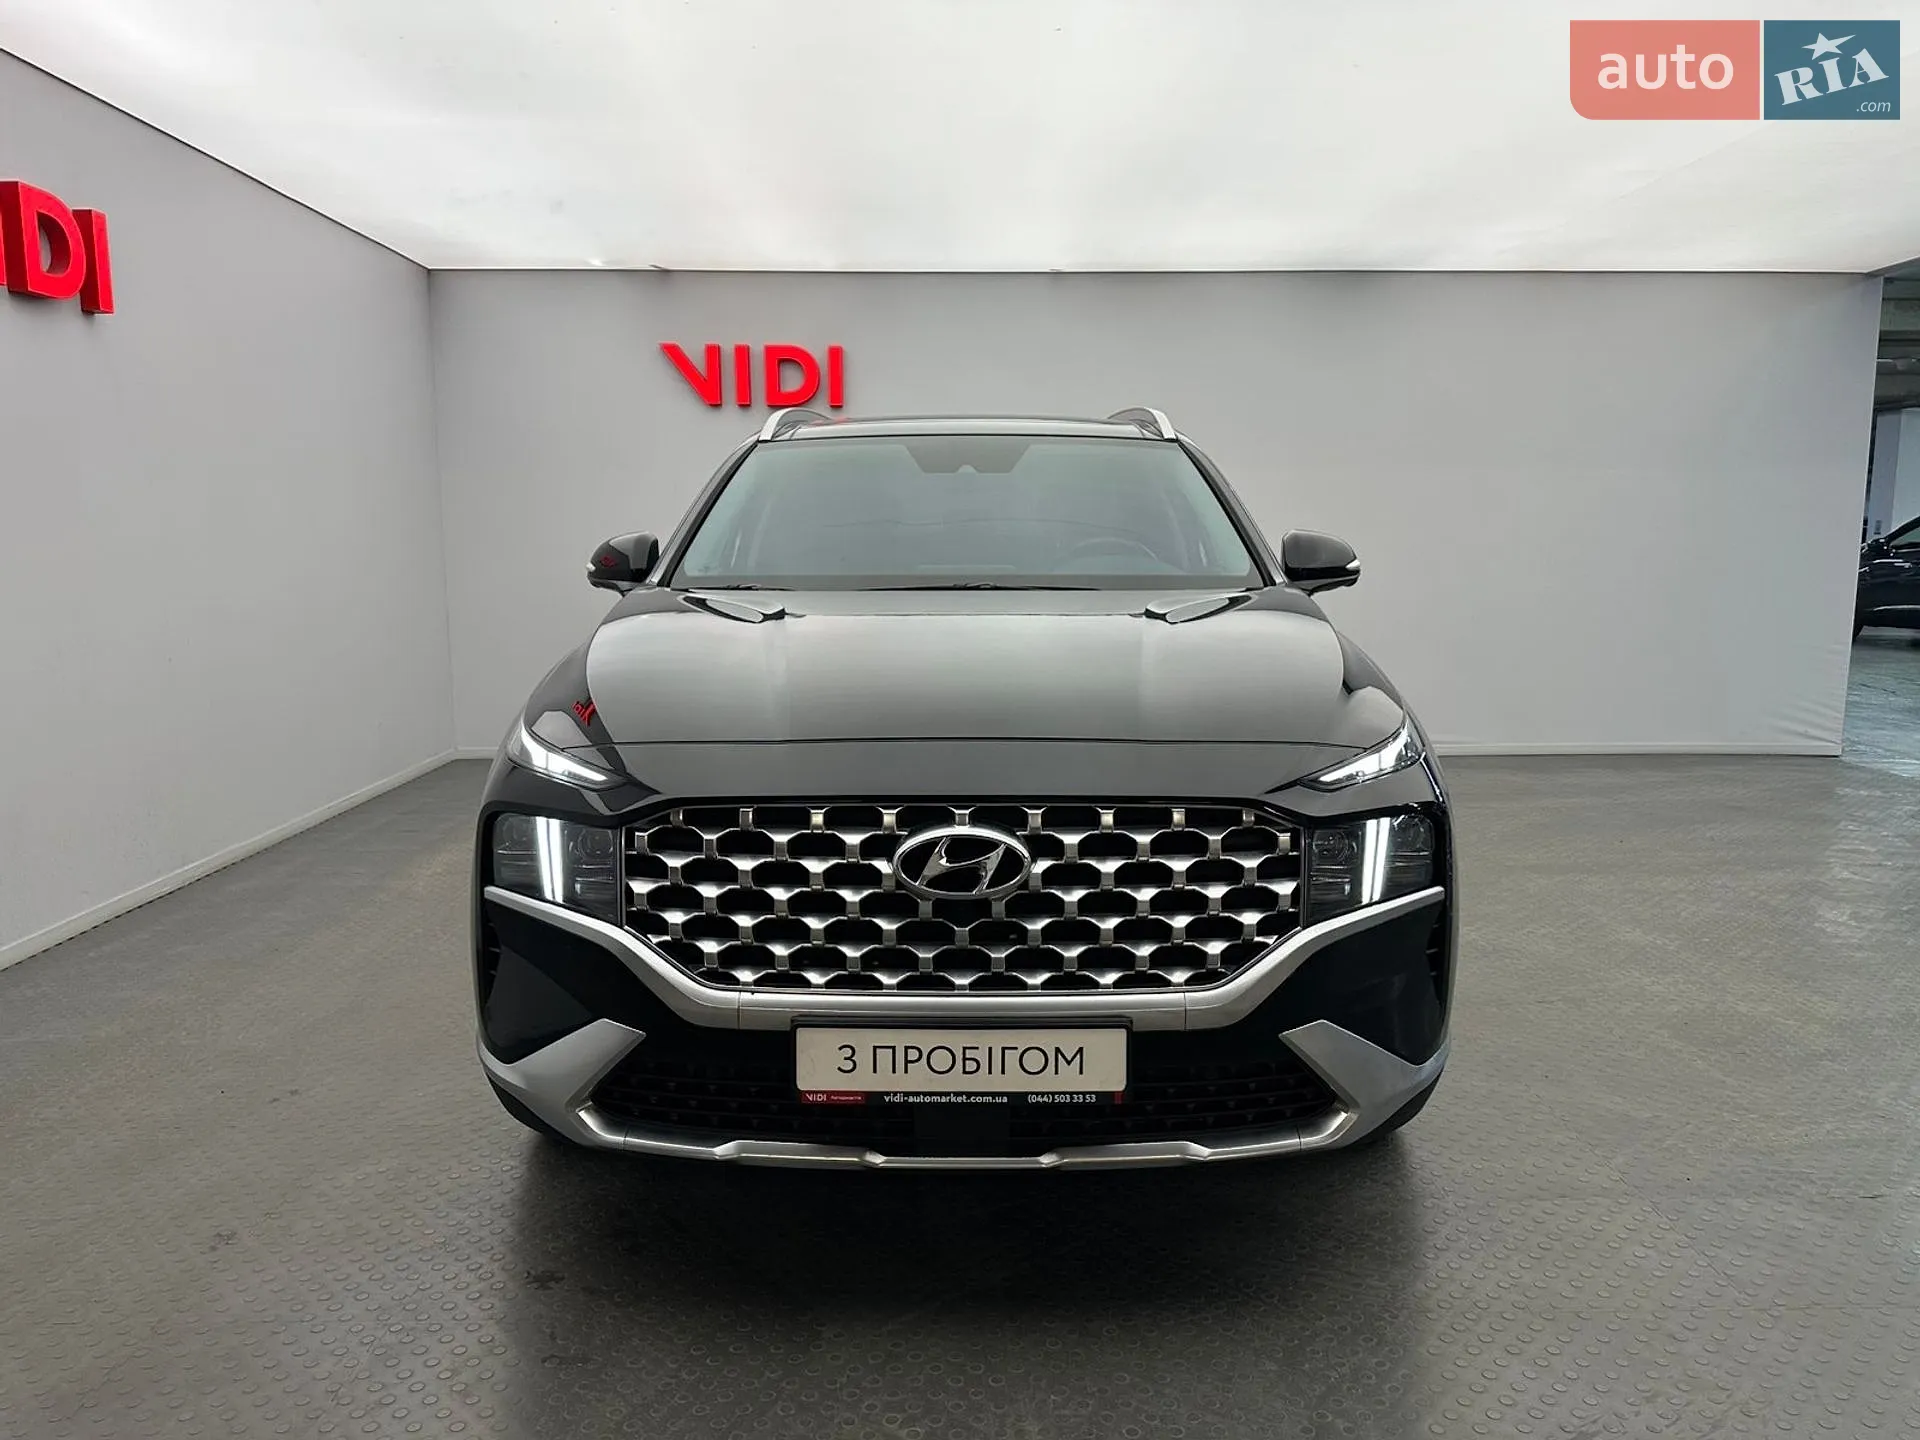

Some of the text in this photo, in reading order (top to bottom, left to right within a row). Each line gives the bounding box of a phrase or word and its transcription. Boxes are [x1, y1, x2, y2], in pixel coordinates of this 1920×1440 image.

[659, 342, 845, 408] VIDI
[872, 1045, 1084, 1075] ПРОБІГОМ
[806, 1093, 827, 1101] VIDI
[884, 1093, 1008, 1103] vidi-automarket.com.ua
[1027, 1094, 1097, 1104] (044) 503 33 53
